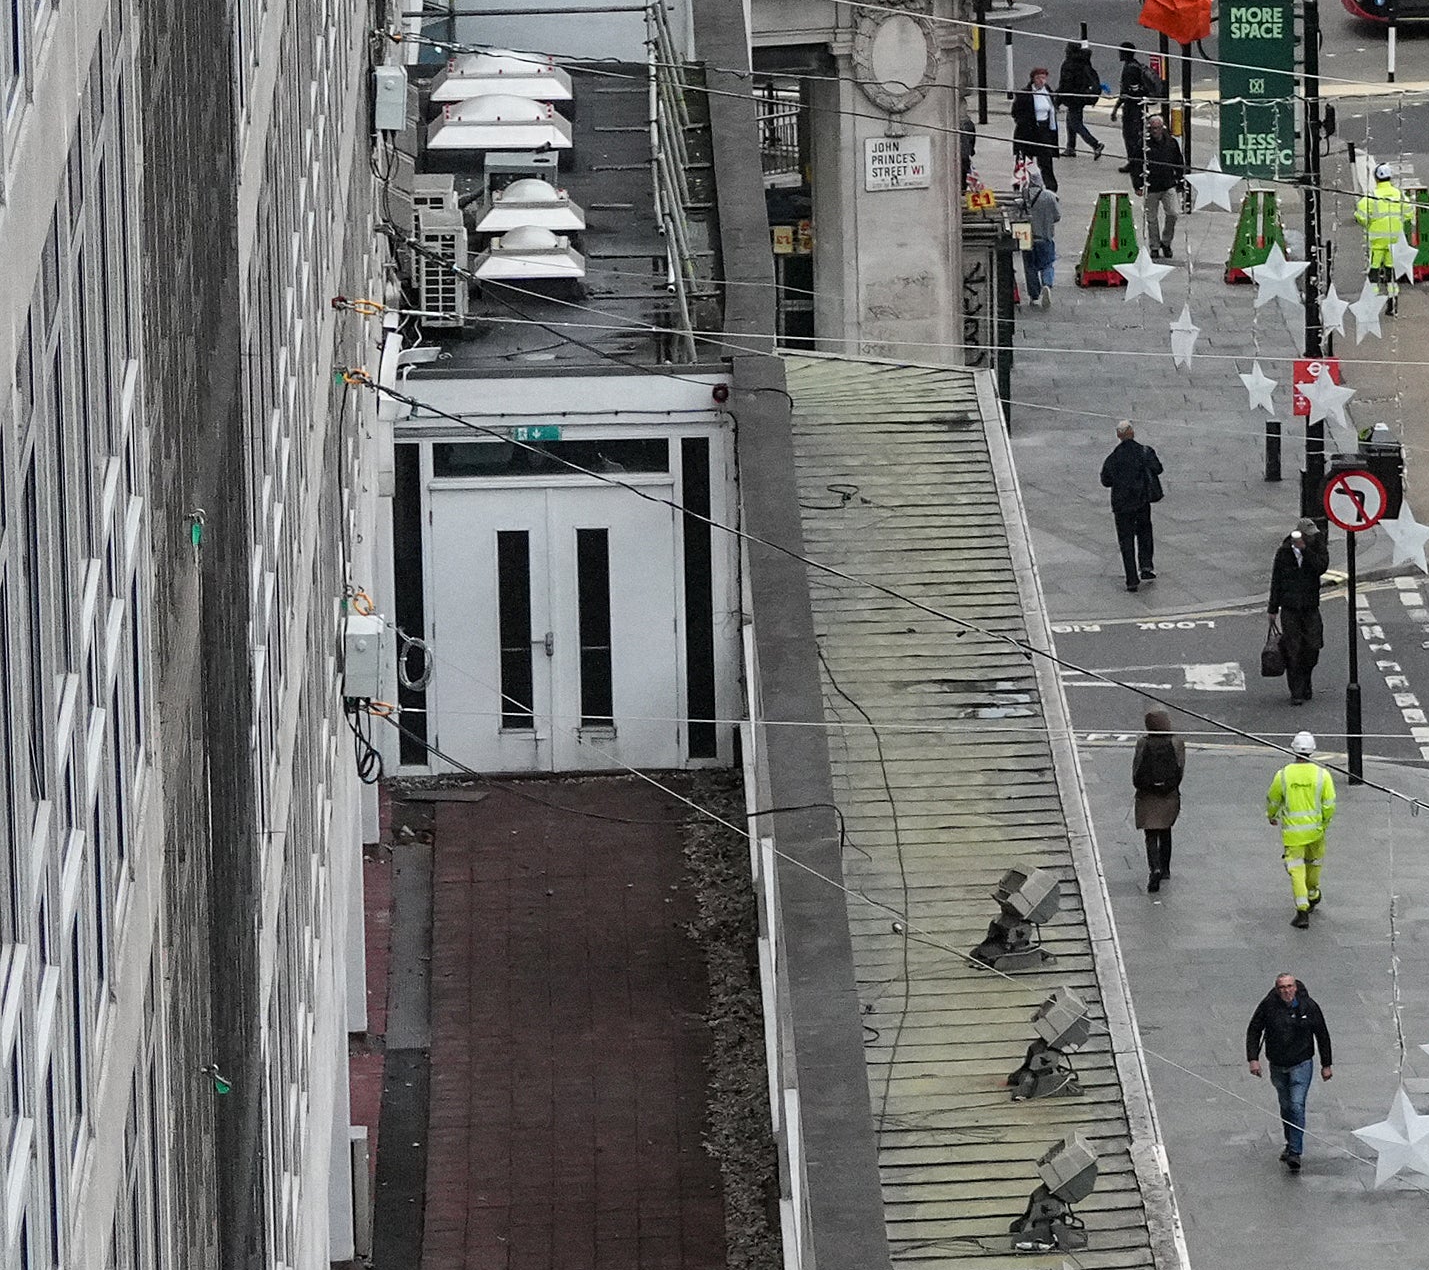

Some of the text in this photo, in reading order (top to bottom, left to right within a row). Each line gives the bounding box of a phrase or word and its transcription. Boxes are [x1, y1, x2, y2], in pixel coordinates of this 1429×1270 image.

[1231, 7, 1283, 22] MORE
[1231, 23, 1283, 39] SPACE
[871, 141, 900, 154] JOHN
[1238, 134, 1277, 150] LESS
[871, 152, 917, 166] PRINCE'S
[1222, 150, 1294, 166] TRAFFC
[871, 165, 925, 178] STREET W1
[972, 193, 992, 207] £1
